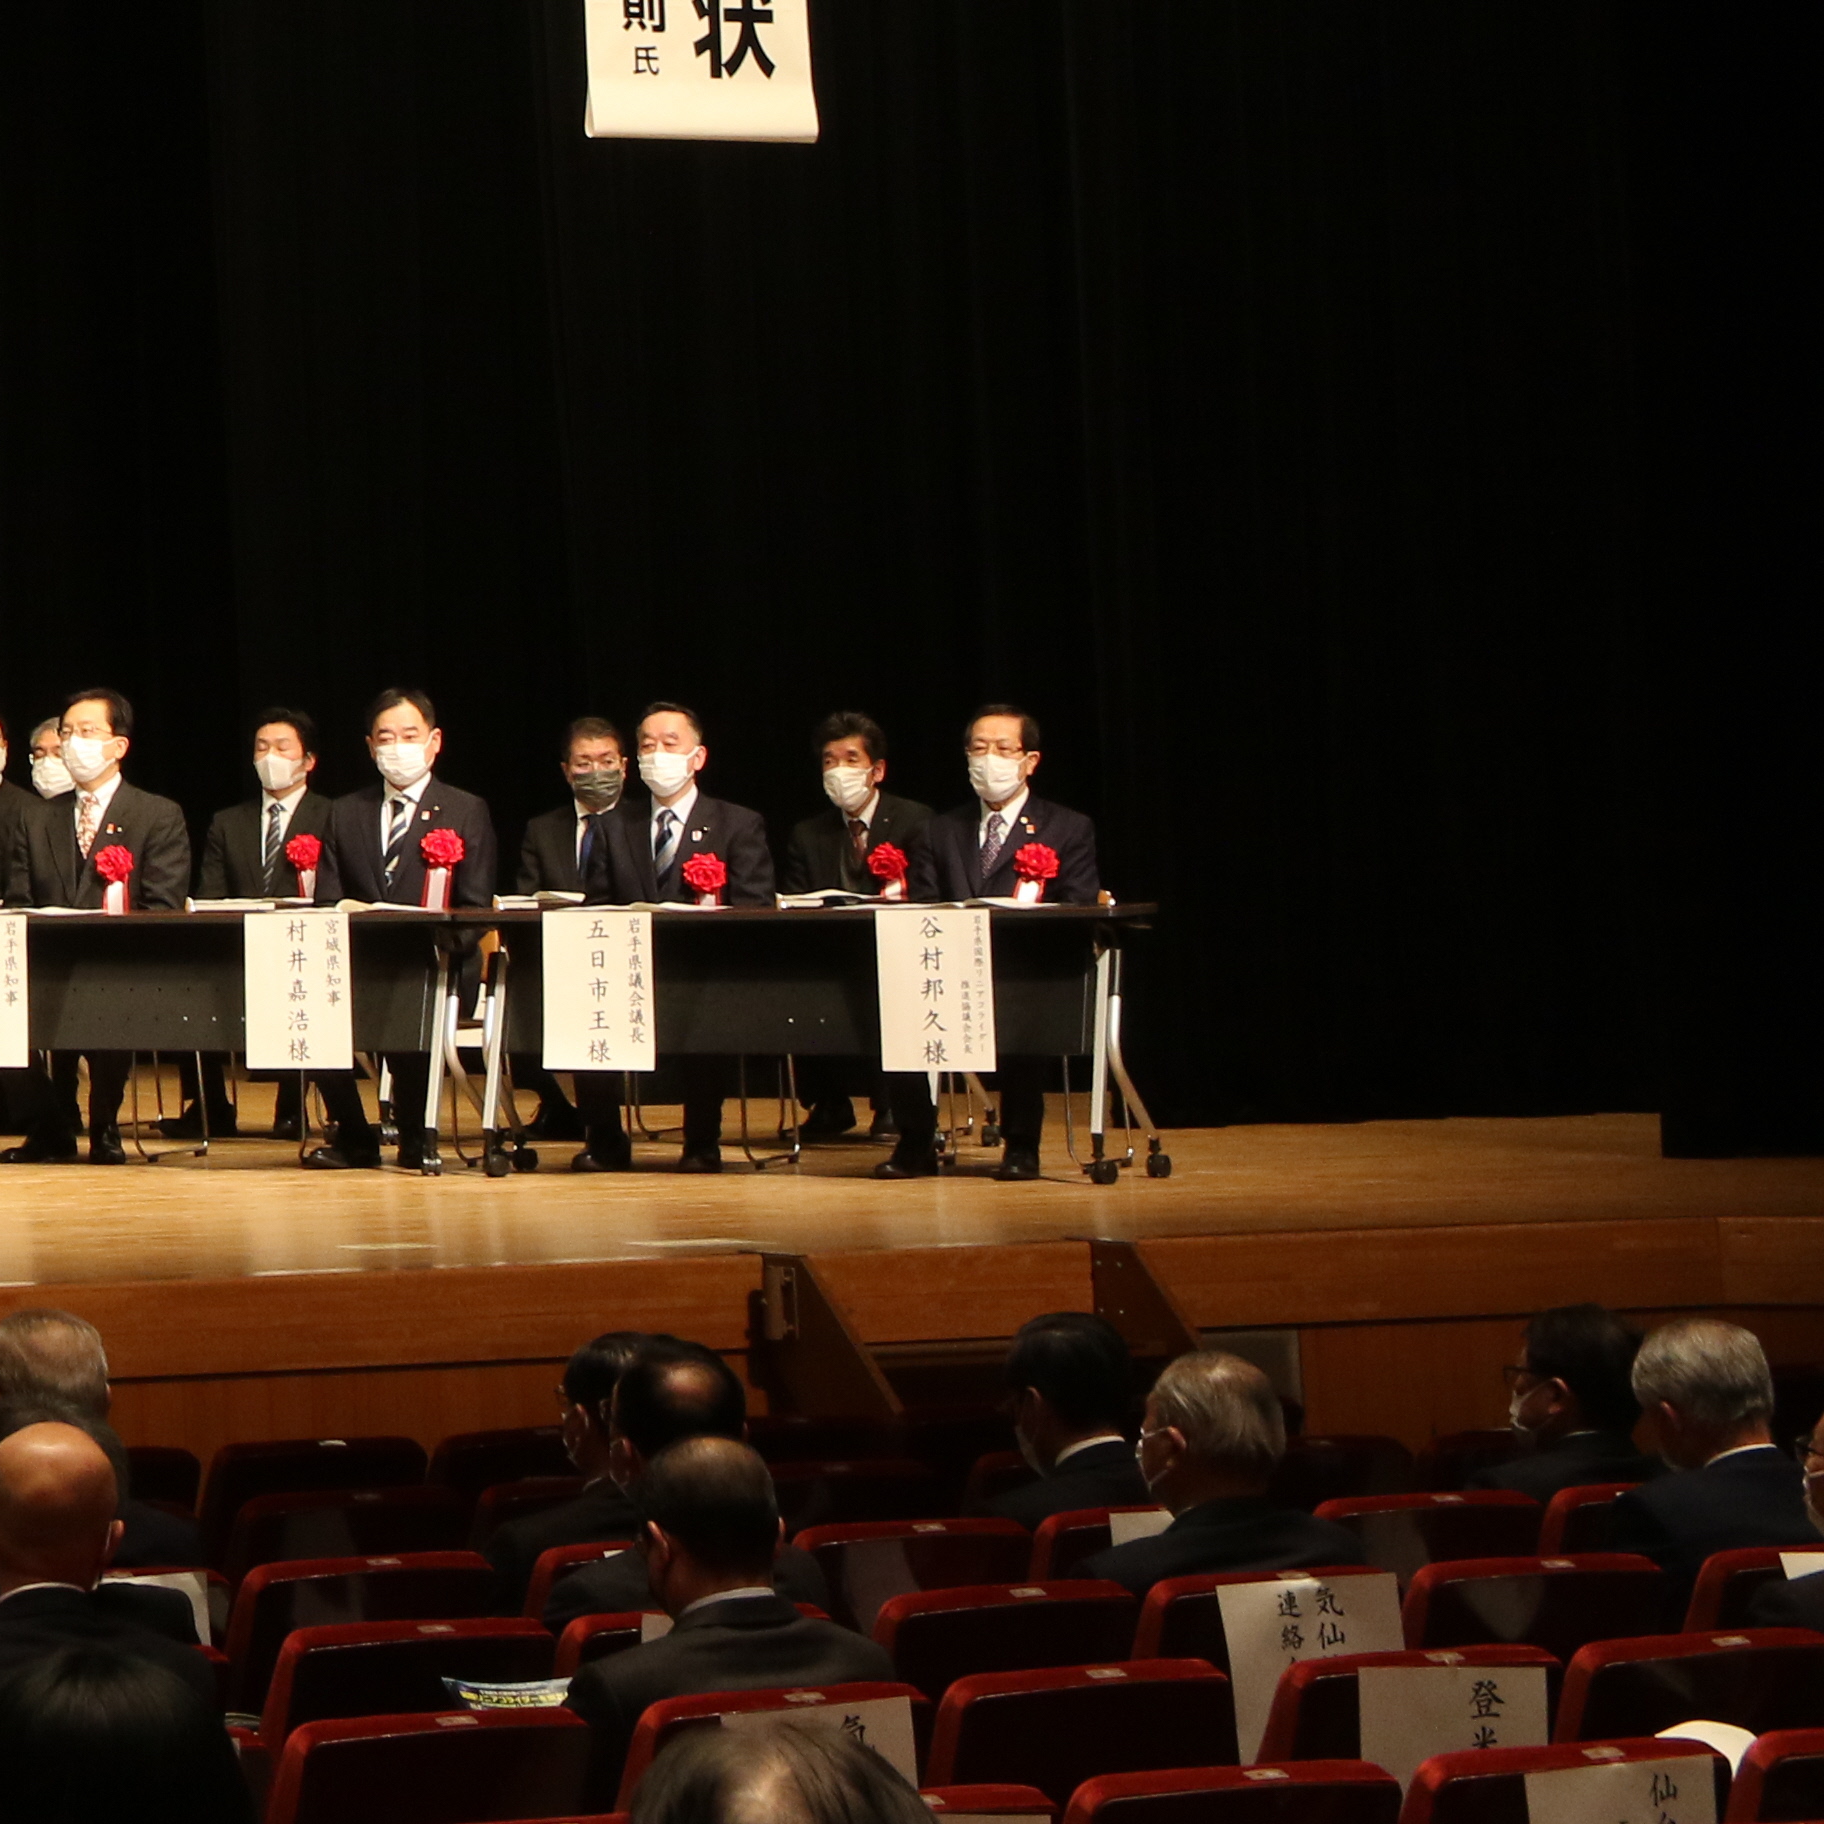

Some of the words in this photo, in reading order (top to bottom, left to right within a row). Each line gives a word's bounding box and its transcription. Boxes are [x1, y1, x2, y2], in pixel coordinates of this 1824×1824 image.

[4, 920, 19, 1007] 岩手県知事
[286, 919, 312, 1062] 村井嘉浩様
[325, 919, 342, 1008] 宮城県知事
[587, 919, 612, 1063] 五日市王様
[627, 918, 646, 1044] 岩手県議会議長
[919, 916, 949, 1065] 谷村邦久様
[1277, 1589, 1304, 1663] 連絡
[1315, 1587, 1346, 1657] 気仙
